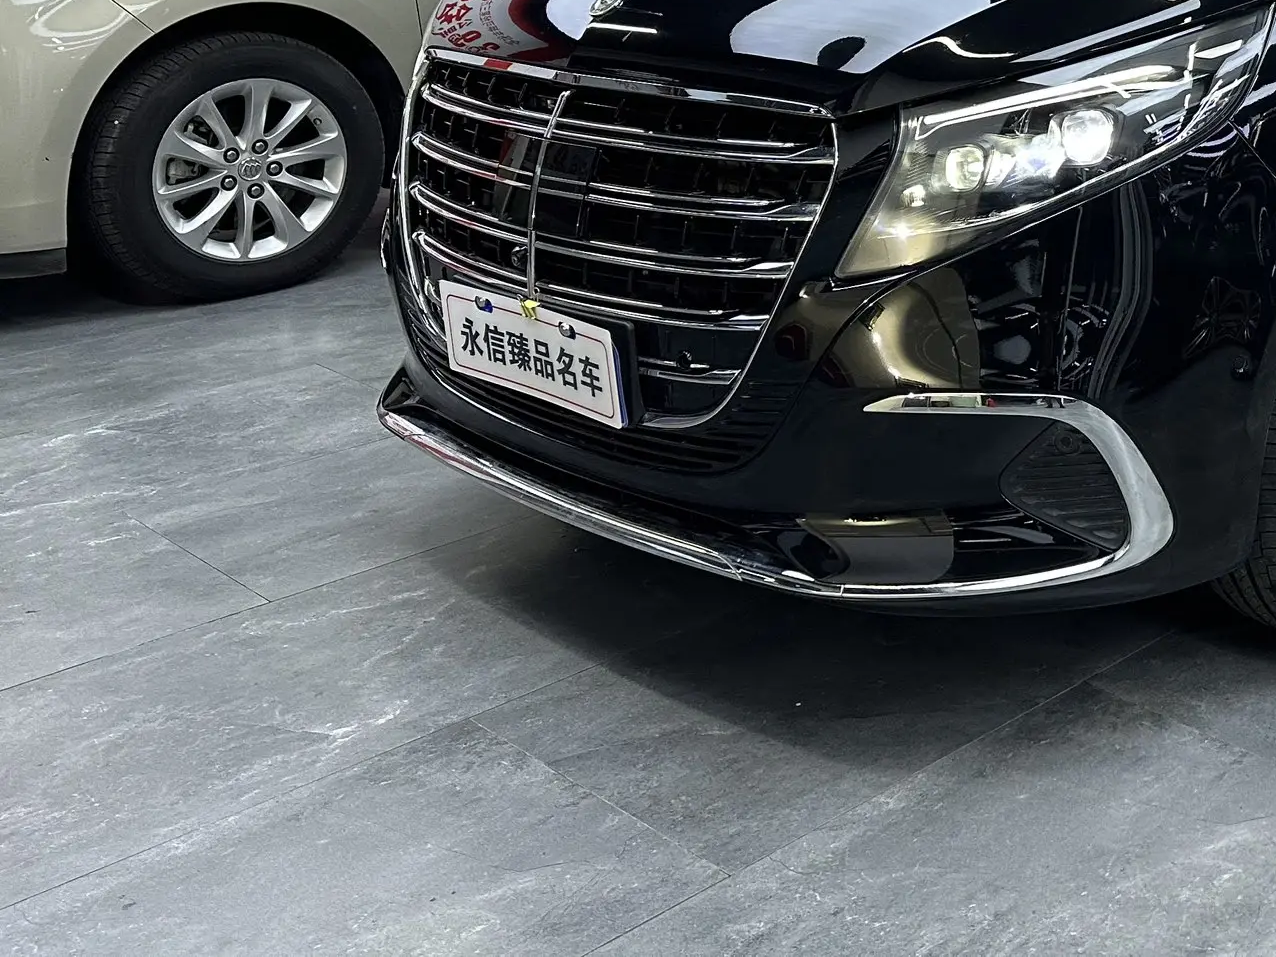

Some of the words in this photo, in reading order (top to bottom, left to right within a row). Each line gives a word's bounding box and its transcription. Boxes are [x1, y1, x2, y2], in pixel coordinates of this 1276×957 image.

[460, 316, 604, 398] 永信臻品名车
